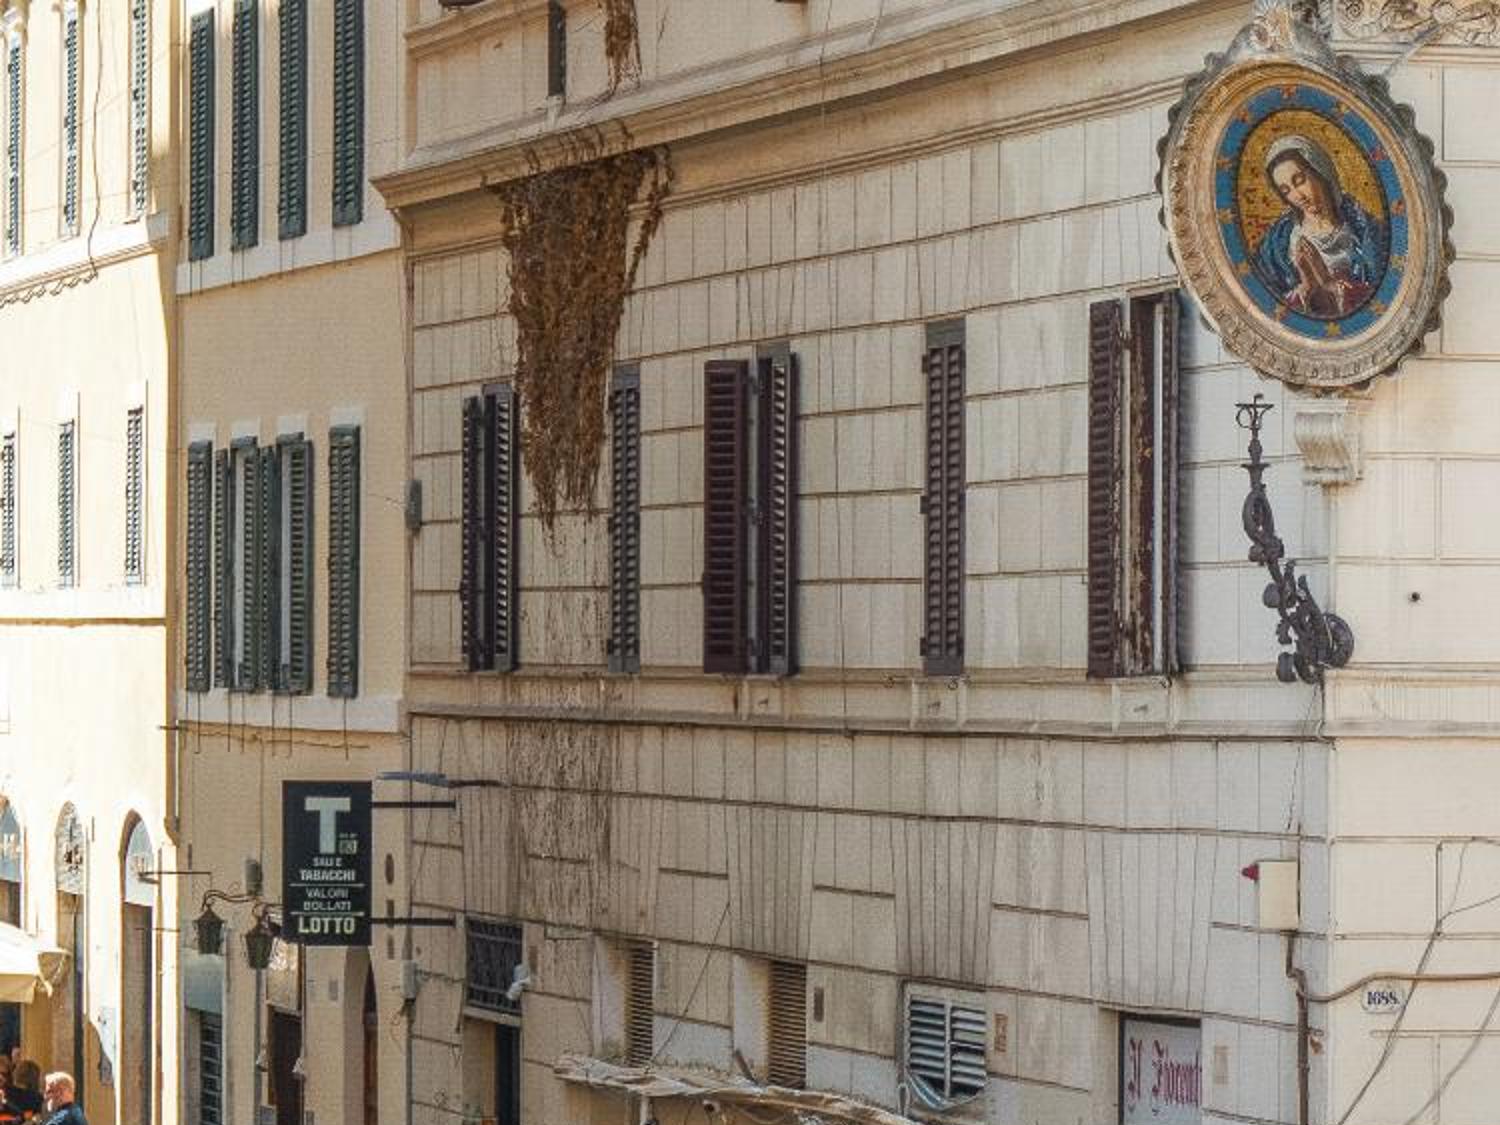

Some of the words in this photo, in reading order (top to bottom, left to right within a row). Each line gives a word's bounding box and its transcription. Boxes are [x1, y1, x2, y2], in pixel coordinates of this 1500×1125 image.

[304, 796, 351, 854] T
[299, 869, 355, 881] TABACCHI
[306, 887, 349, 898] VALORI
[303, 901, 351, 911] BOLLATI
[298, 917, 355, 934] LOTTO
